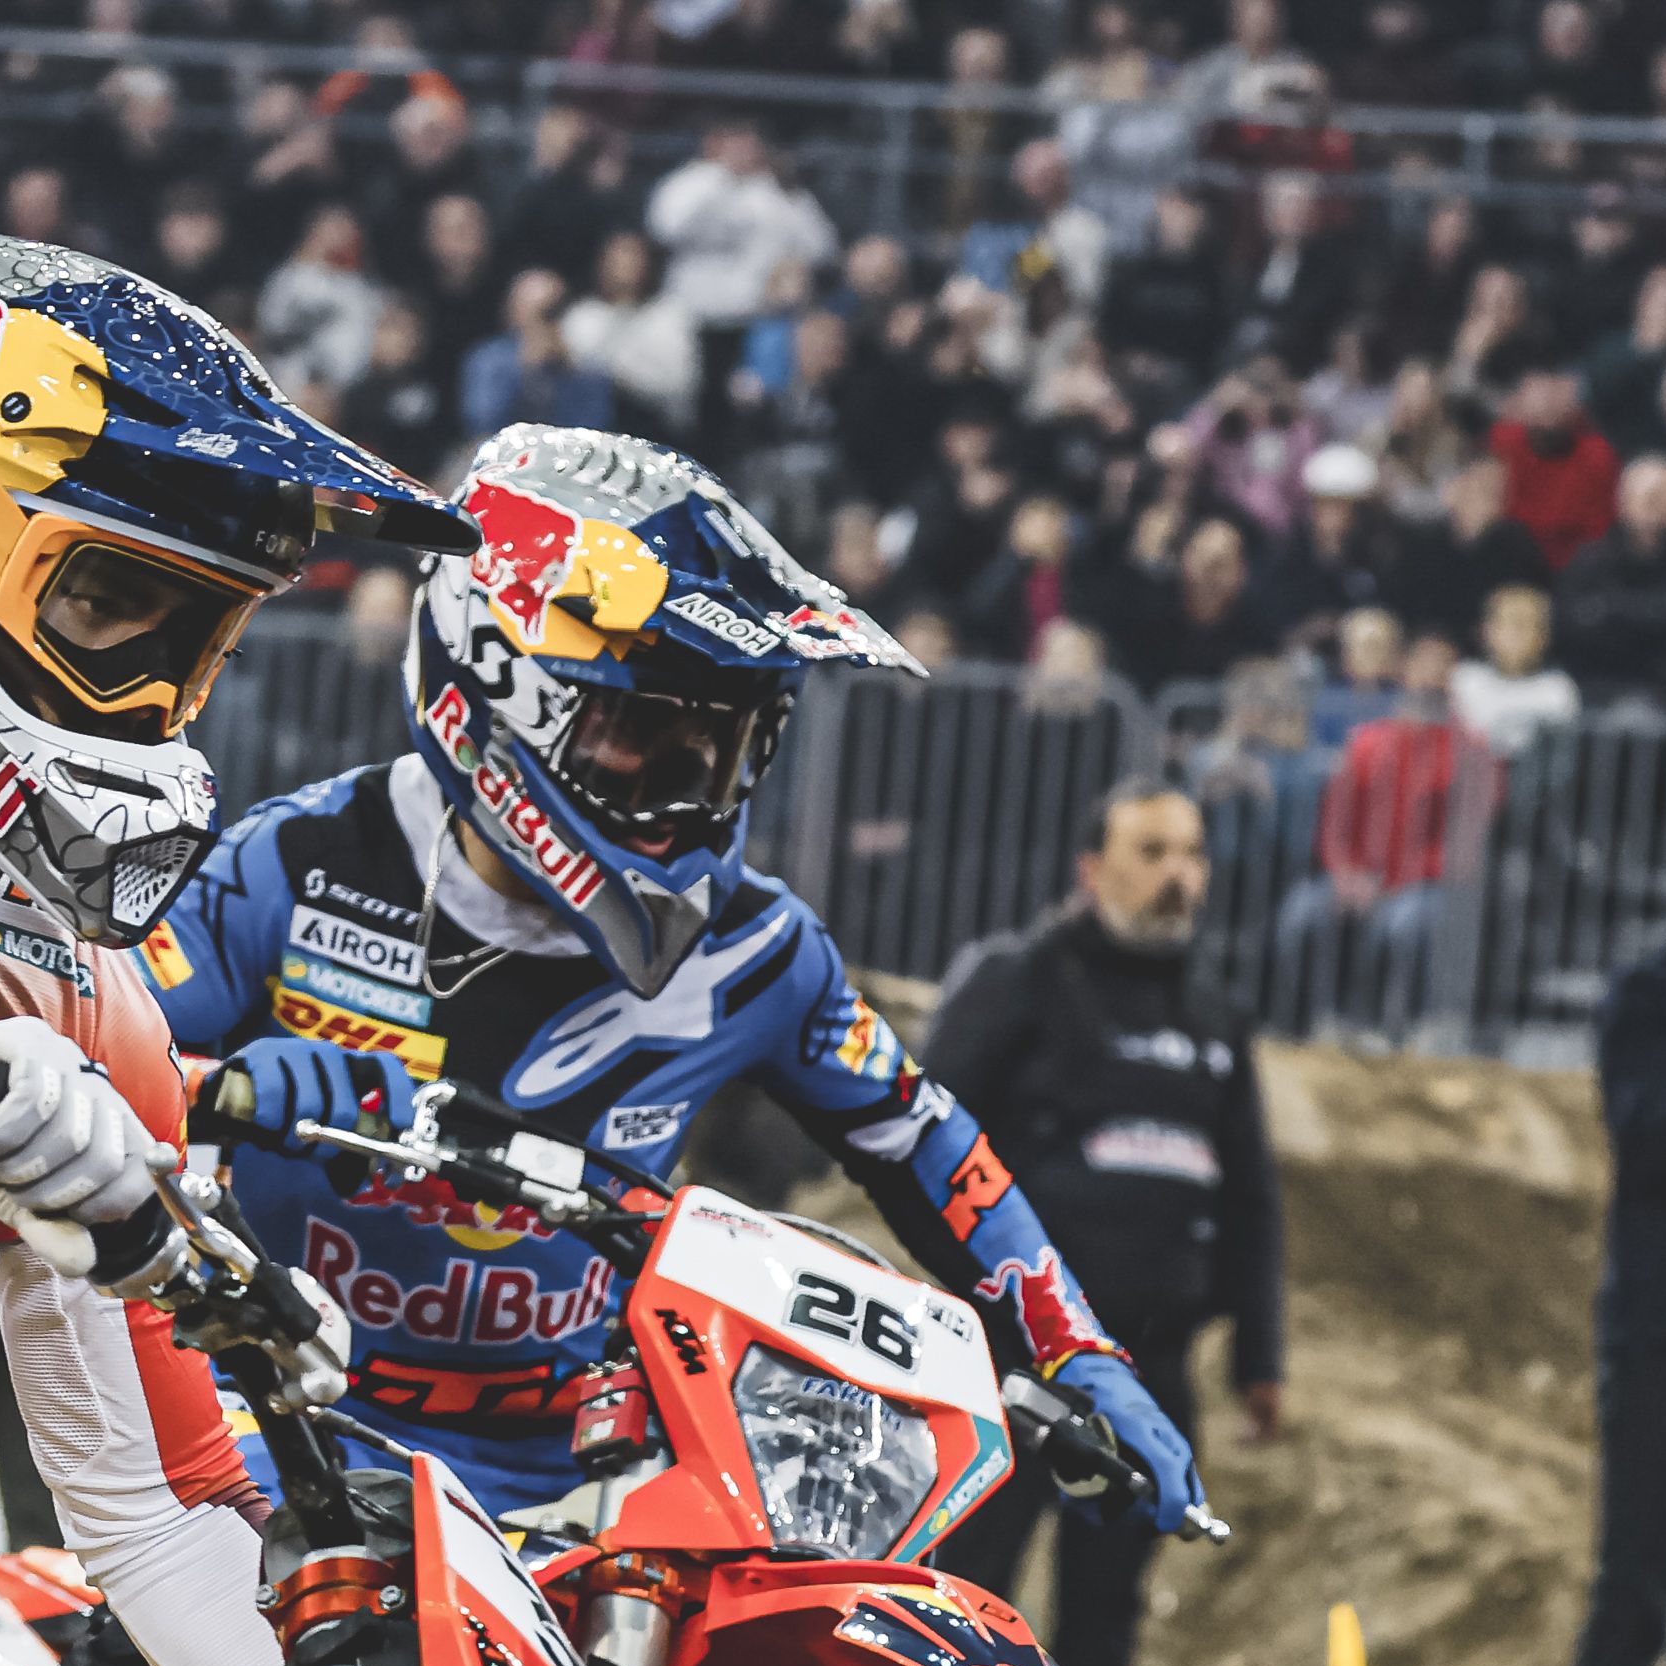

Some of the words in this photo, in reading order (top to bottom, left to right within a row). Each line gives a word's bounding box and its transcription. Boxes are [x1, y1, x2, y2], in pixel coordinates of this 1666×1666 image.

[671, 594, 779, 655] AIROH
[300, 916, 415, 977] AIROH
[304, 1217, 468, 1339] Red
[473, 1256, 618, 1345] Bull
[788, 1269, 923, 1372] 26
